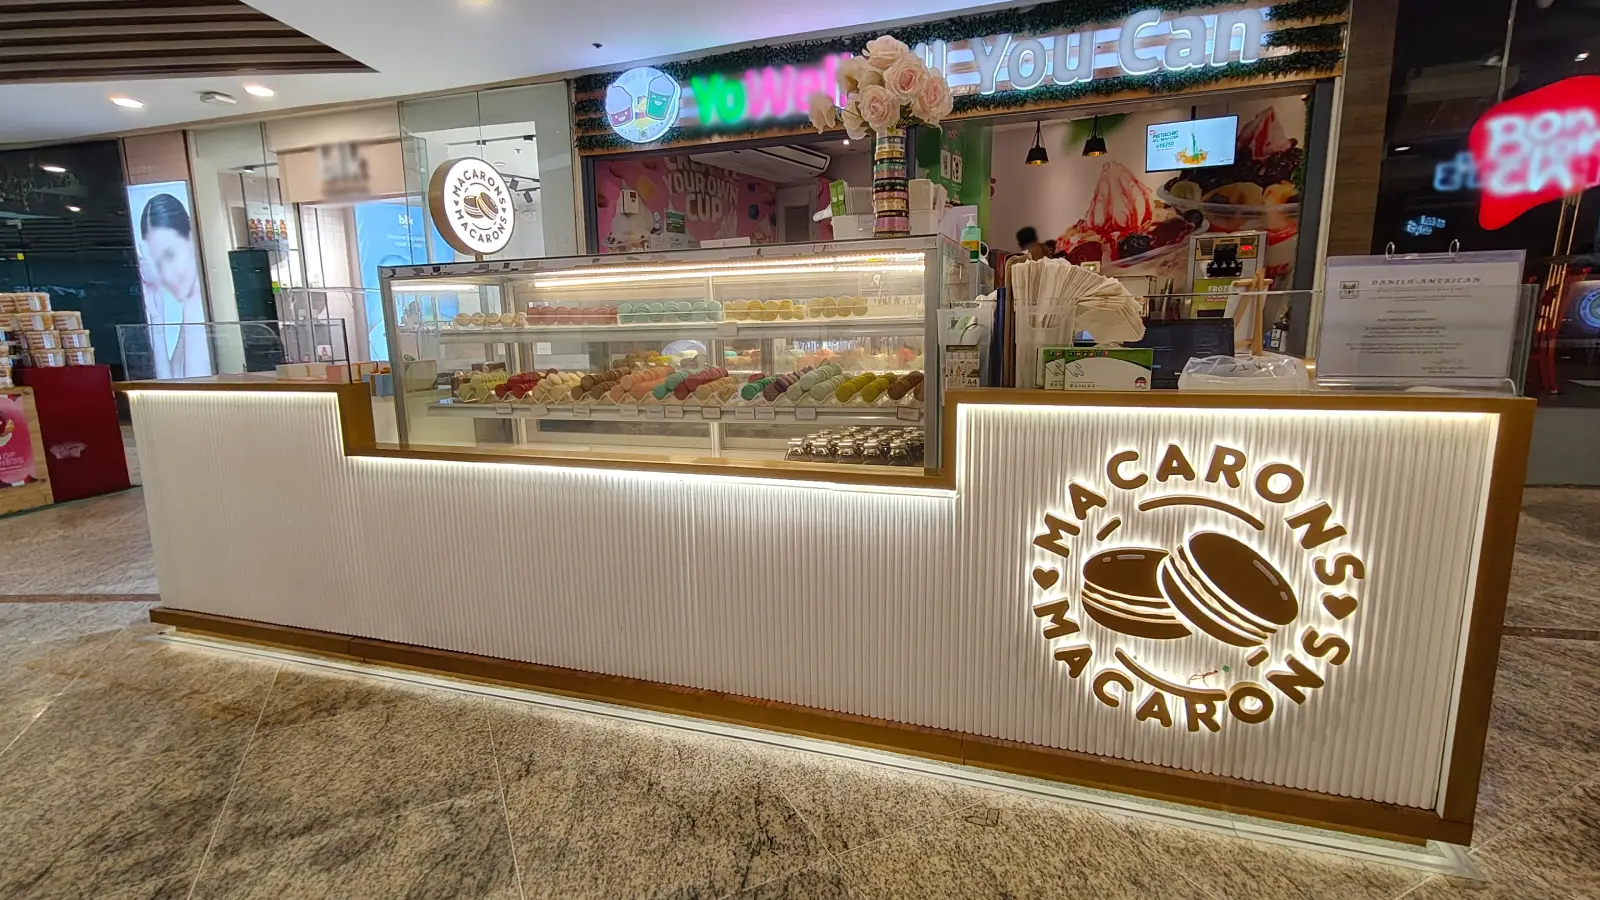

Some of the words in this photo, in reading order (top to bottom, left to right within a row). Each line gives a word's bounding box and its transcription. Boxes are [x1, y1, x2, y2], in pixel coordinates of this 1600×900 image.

[971, 30, 1097, 96] You
[1118, 8, 1264, 77] Can
[452, 169, 506, 205] MACARONS
[661, 171, 706, 195] YOUR
[706, 175, 741, 206] OWN
[685, 192, 724, 222] CUP
[454, 209, 507, 243] MACARONS
[1207, 284, 1231, 293] FROZ
[1032, 443, 1365, 586] MACARONS
[1032, 596, 1351, 733] MACARONS
